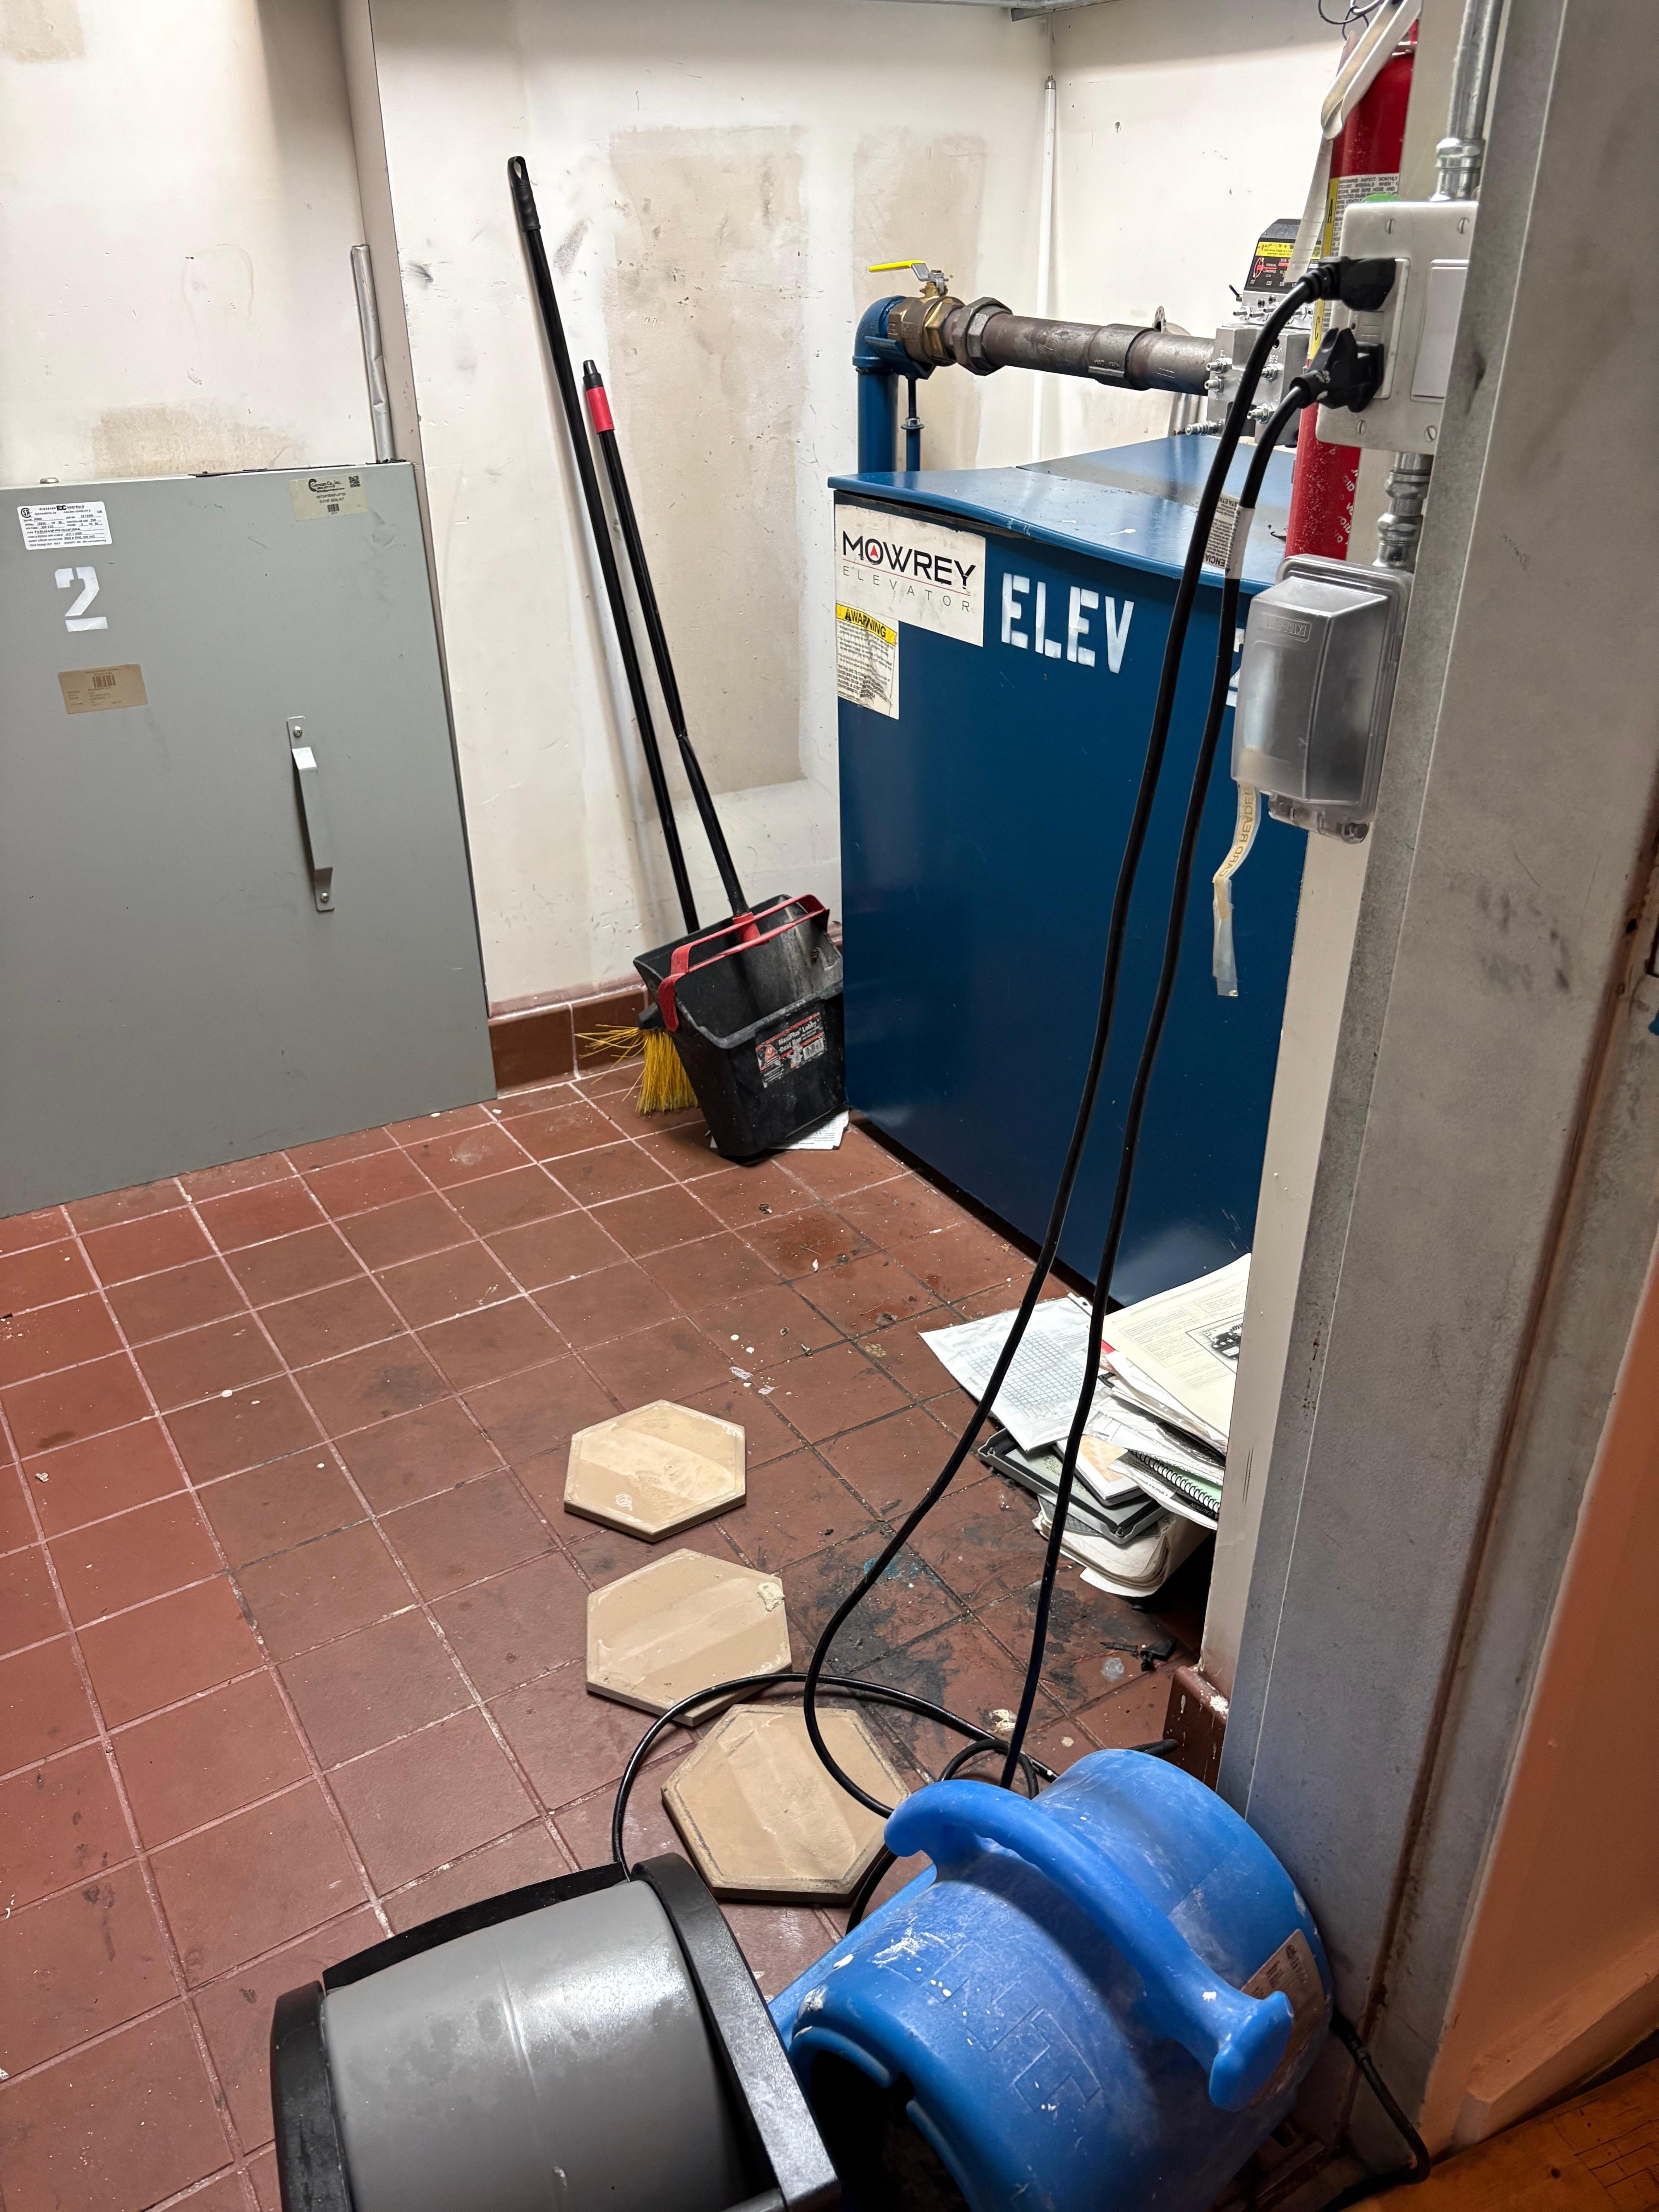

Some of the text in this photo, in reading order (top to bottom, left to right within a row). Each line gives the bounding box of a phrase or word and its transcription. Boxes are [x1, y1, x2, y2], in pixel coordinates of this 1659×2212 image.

[1327, 199, 1333, 223] A
[843, 531, 976, 590] MOWREY
[55, 566, 108, 632] 2
[843, 565, 970, 612] ELEVATOR
[851, 610, 886, 639] WARNING
[1001, 572, 1135, 674] ELEV
[802, 1020, 817, 1032] Lobby
[1190, 1503, 1213, 1516] CAUTION
